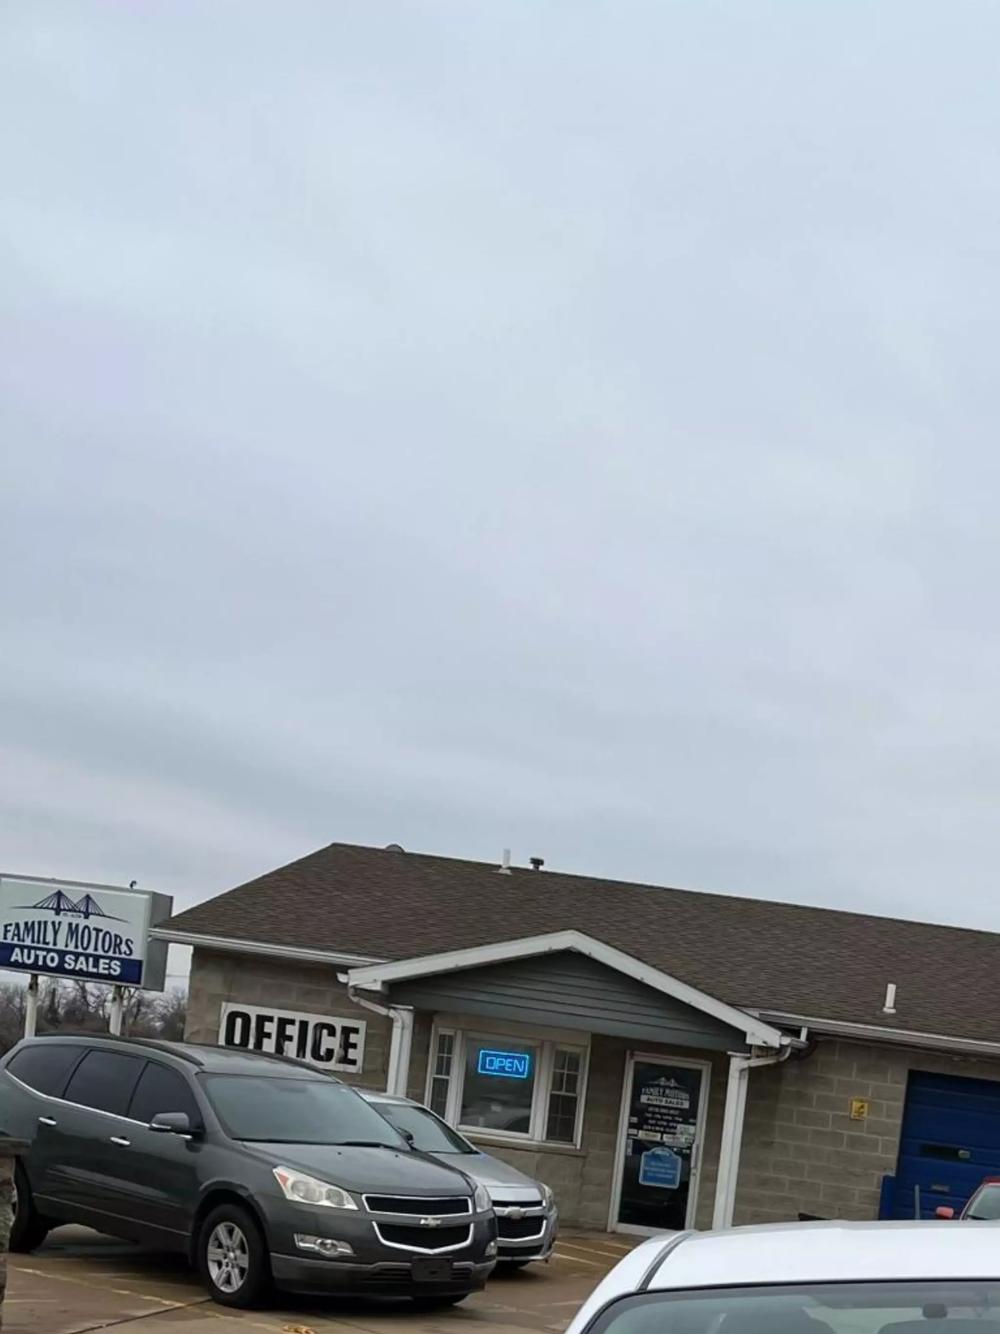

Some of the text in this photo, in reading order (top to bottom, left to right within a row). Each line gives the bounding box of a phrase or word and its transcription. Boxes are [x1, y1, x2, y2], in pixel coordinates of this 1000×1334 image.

[3, 920, 134, 956] FAMILY MOTORS
[10, 947, 121, 976] AUTO SALES
[224, 1010, 360, 1066] OFFICE
[485, 1056, 525, 1072] OPEN
